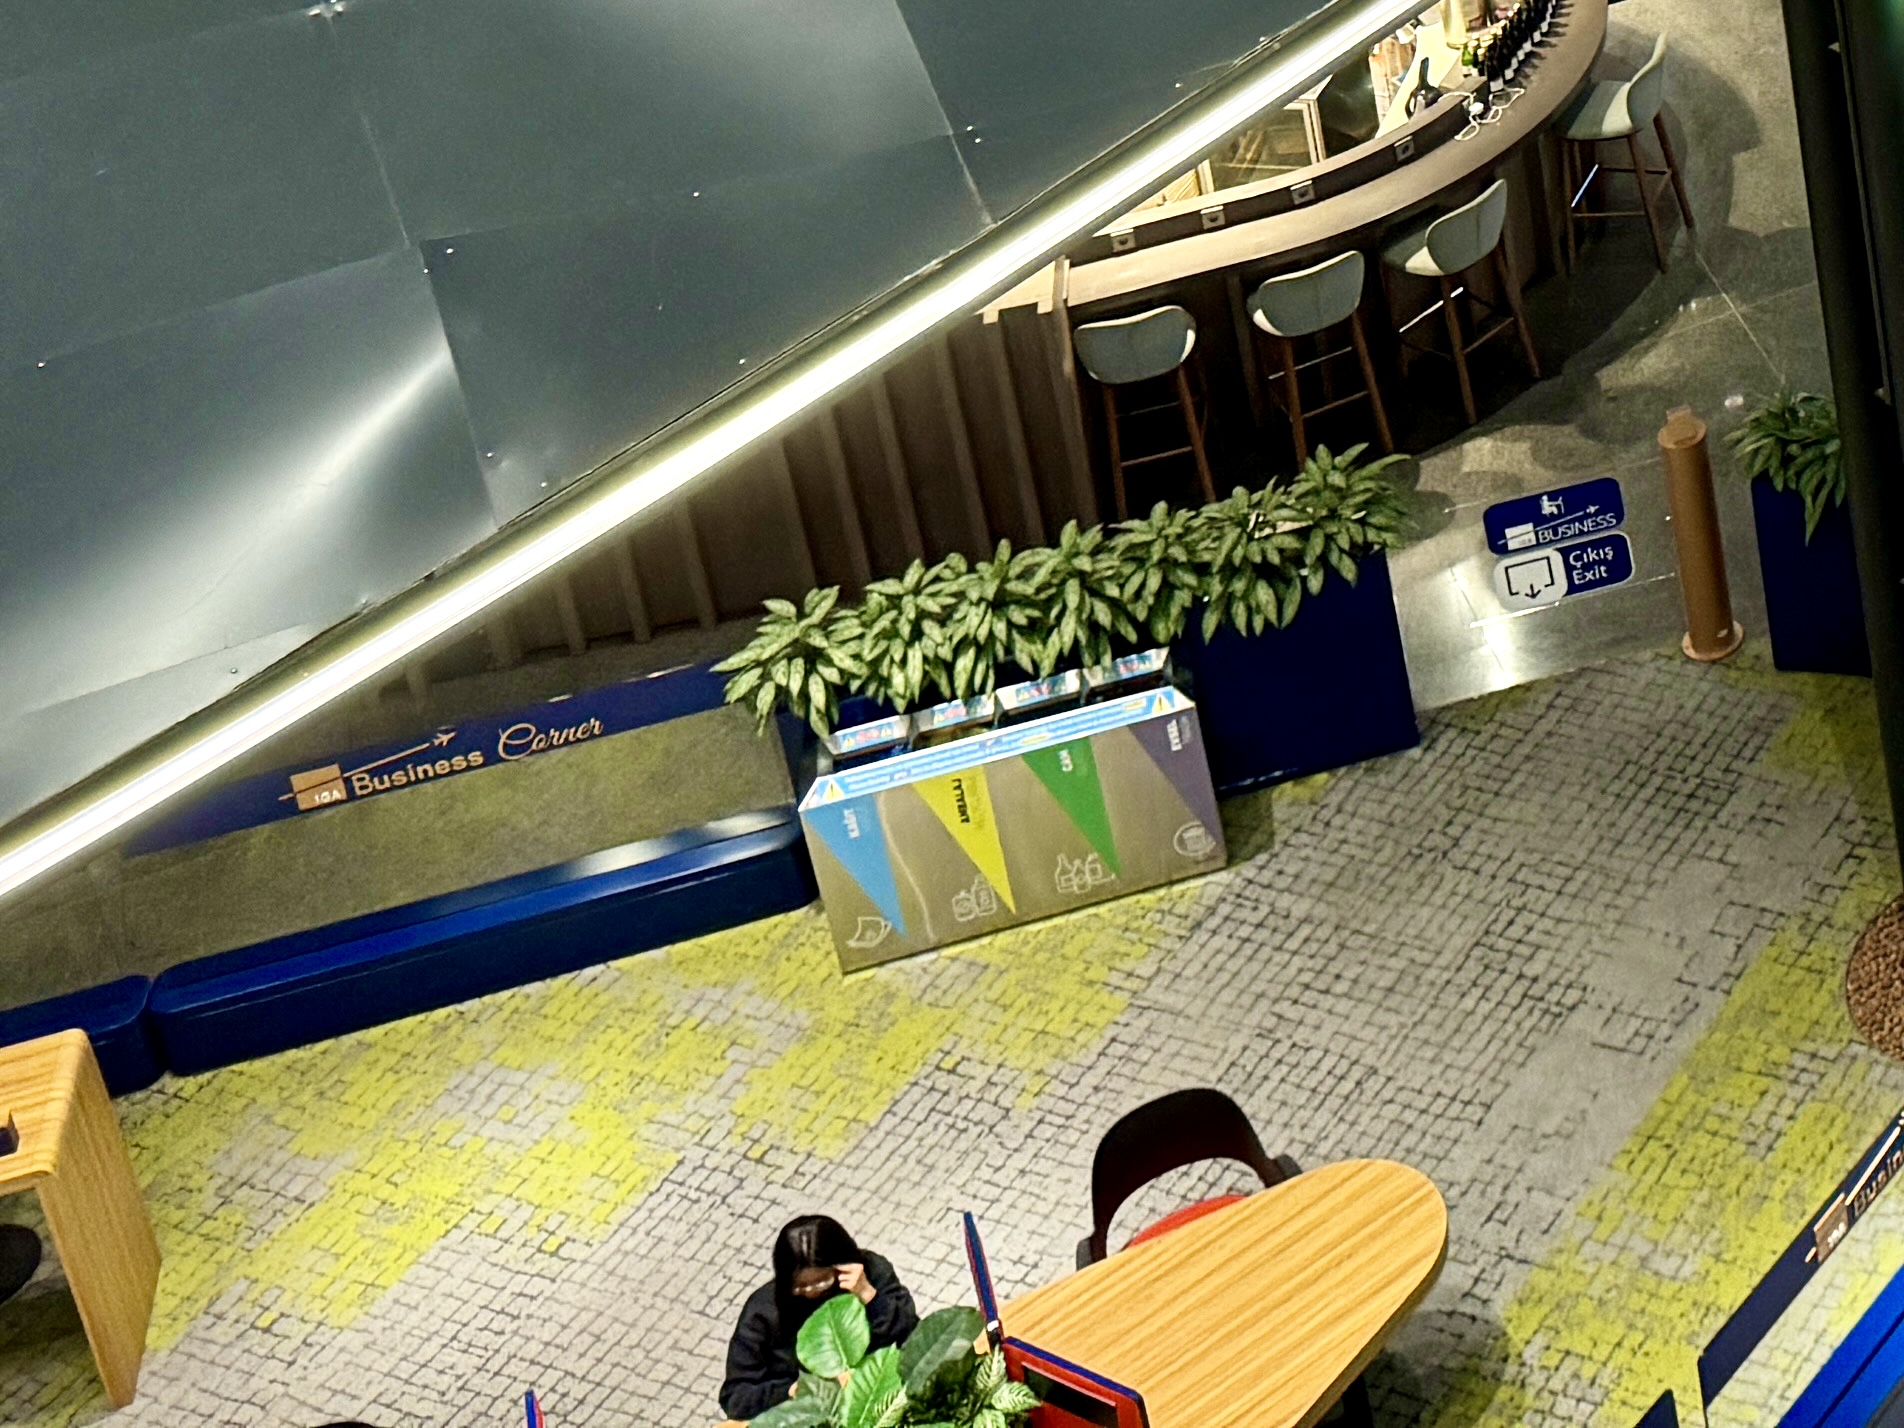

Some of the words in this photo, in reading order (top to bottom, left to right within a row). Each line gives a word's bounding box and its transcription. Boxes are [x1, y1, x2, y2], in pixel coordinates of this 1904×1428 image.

[1538, 512, 1618, 544] BUSINESS
[1569, 545, 1614, 569] Çıkış
[1572, 564, 1608, 586] Exit
[350, 749, 485, 798] Business
[498, 716, 604, 762] Corner
